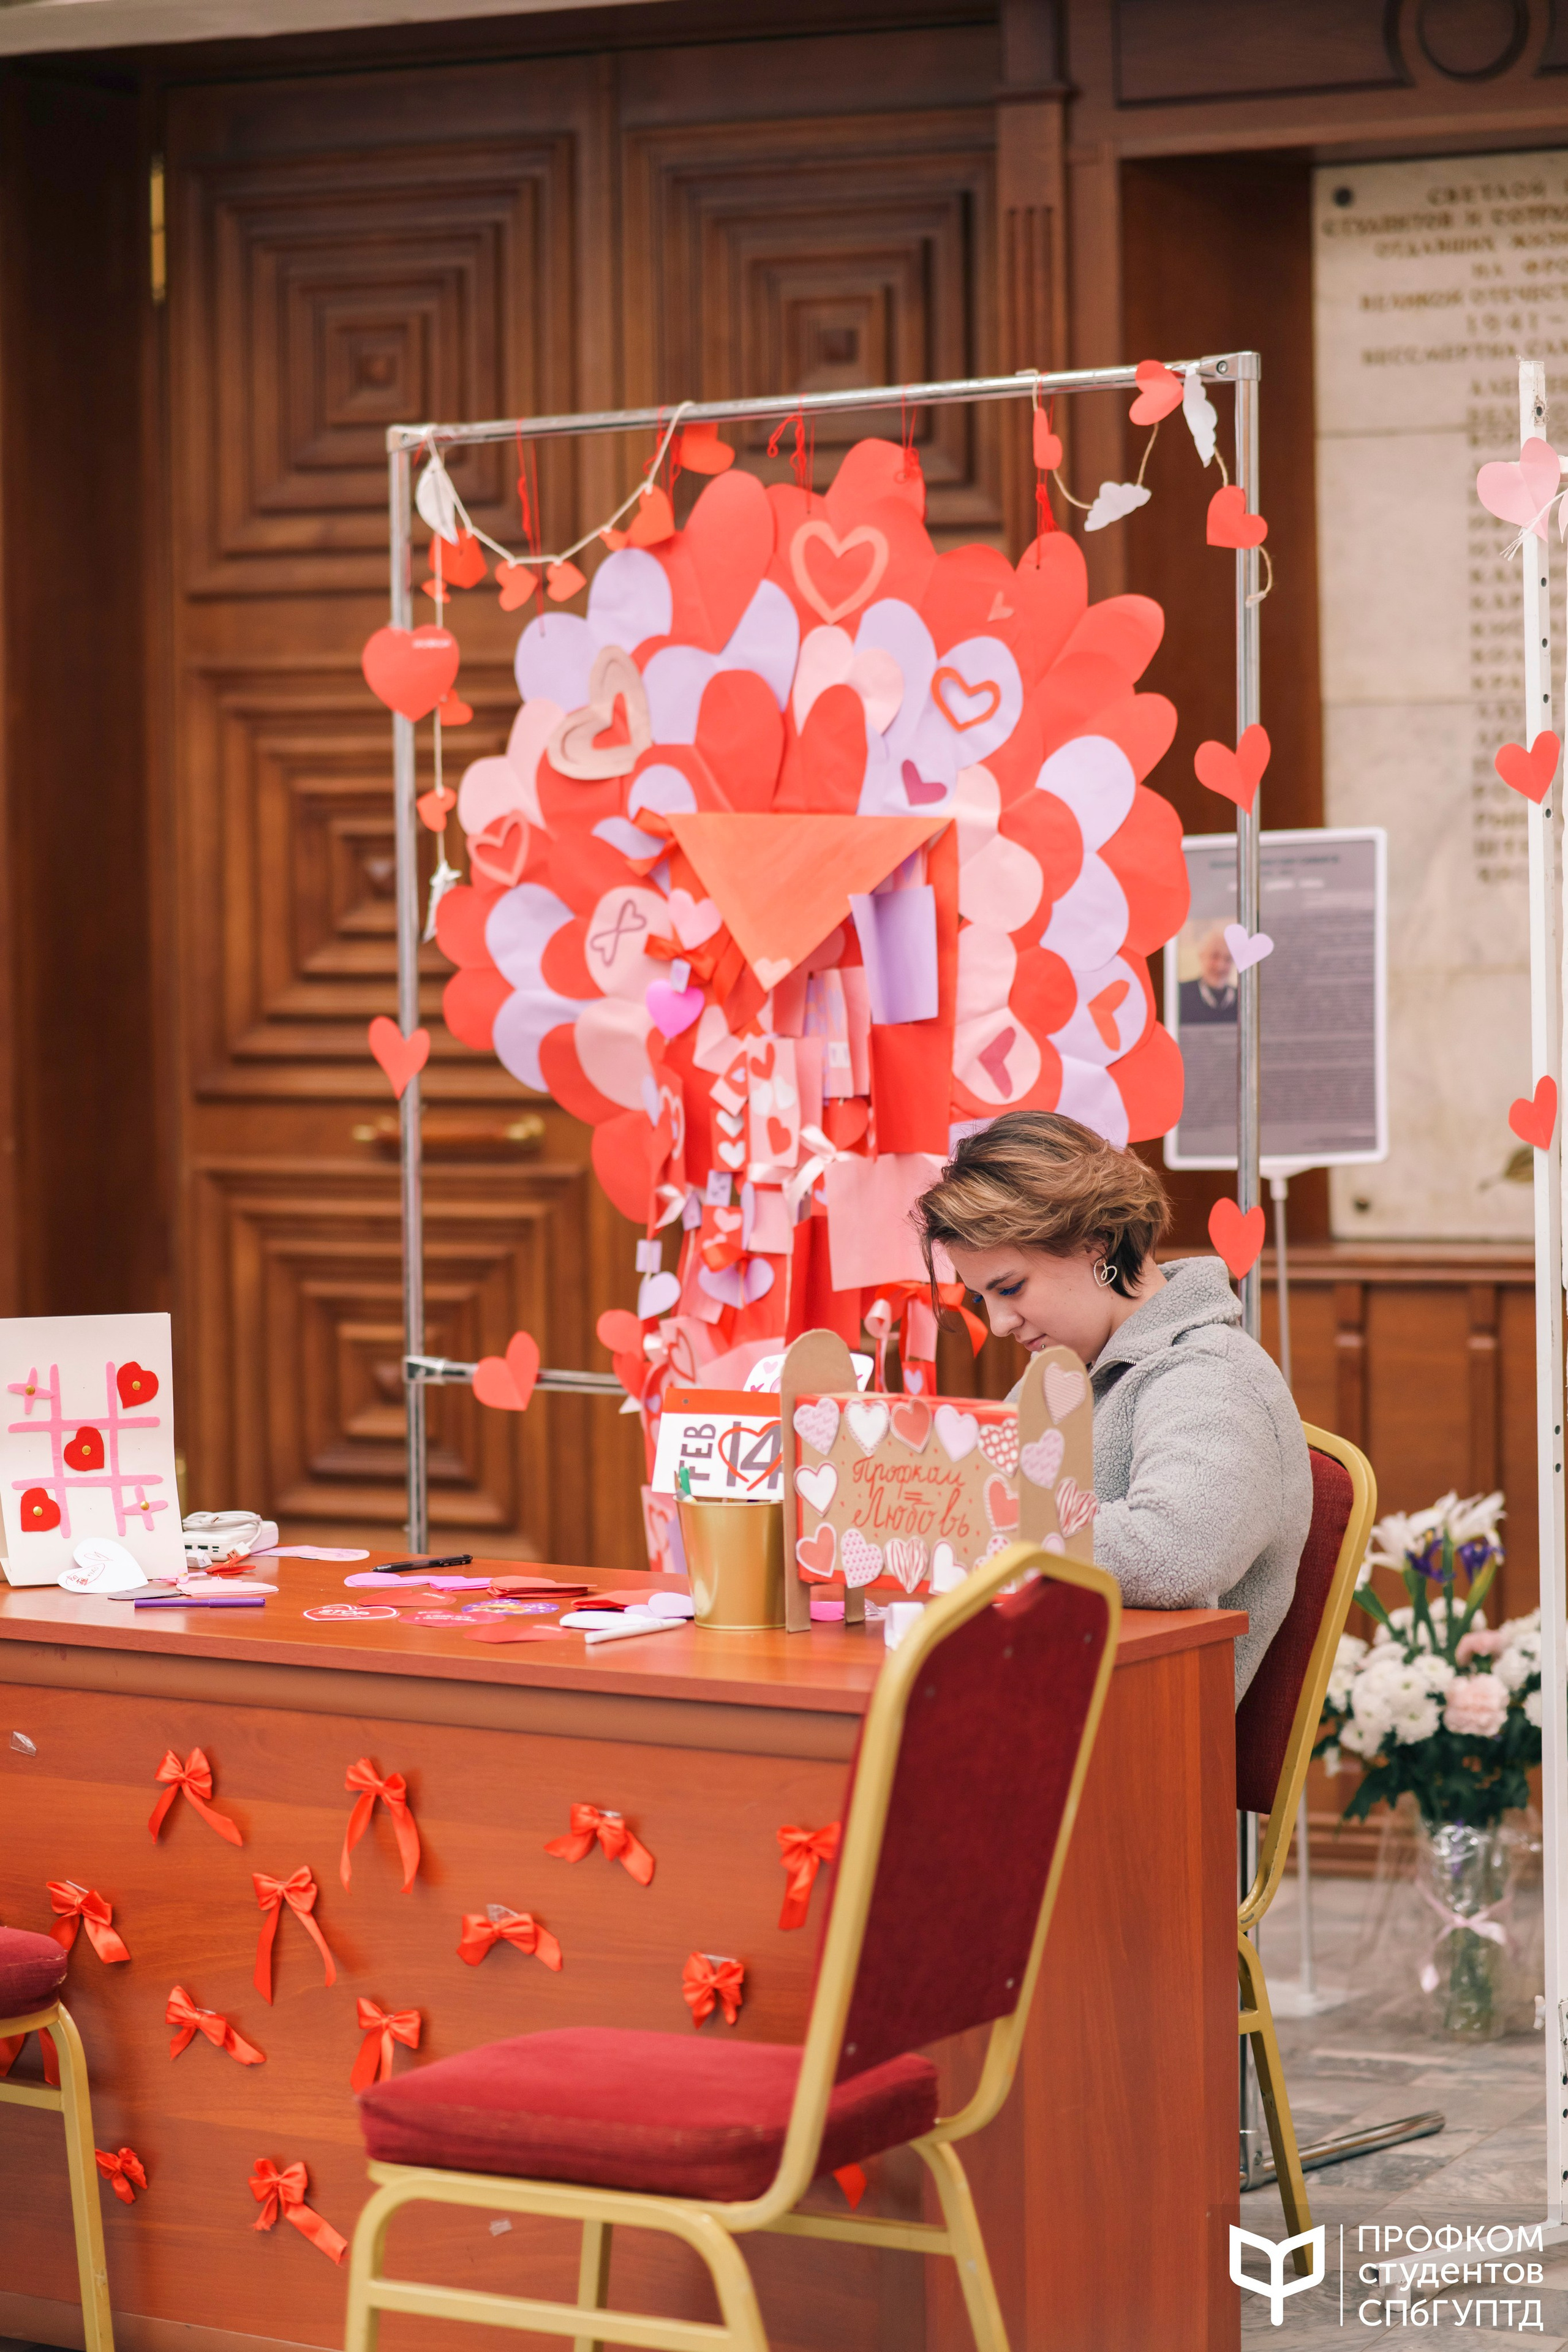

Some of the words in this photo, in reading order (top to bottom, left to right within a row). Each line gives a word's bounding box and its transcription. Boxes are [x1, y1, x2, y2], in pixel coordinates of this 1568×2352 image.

[679, 1423, 717, 1481] FEB
[726, 1421, 783, 1490] 14
[851, 1486, 970, 1538] Любовь
